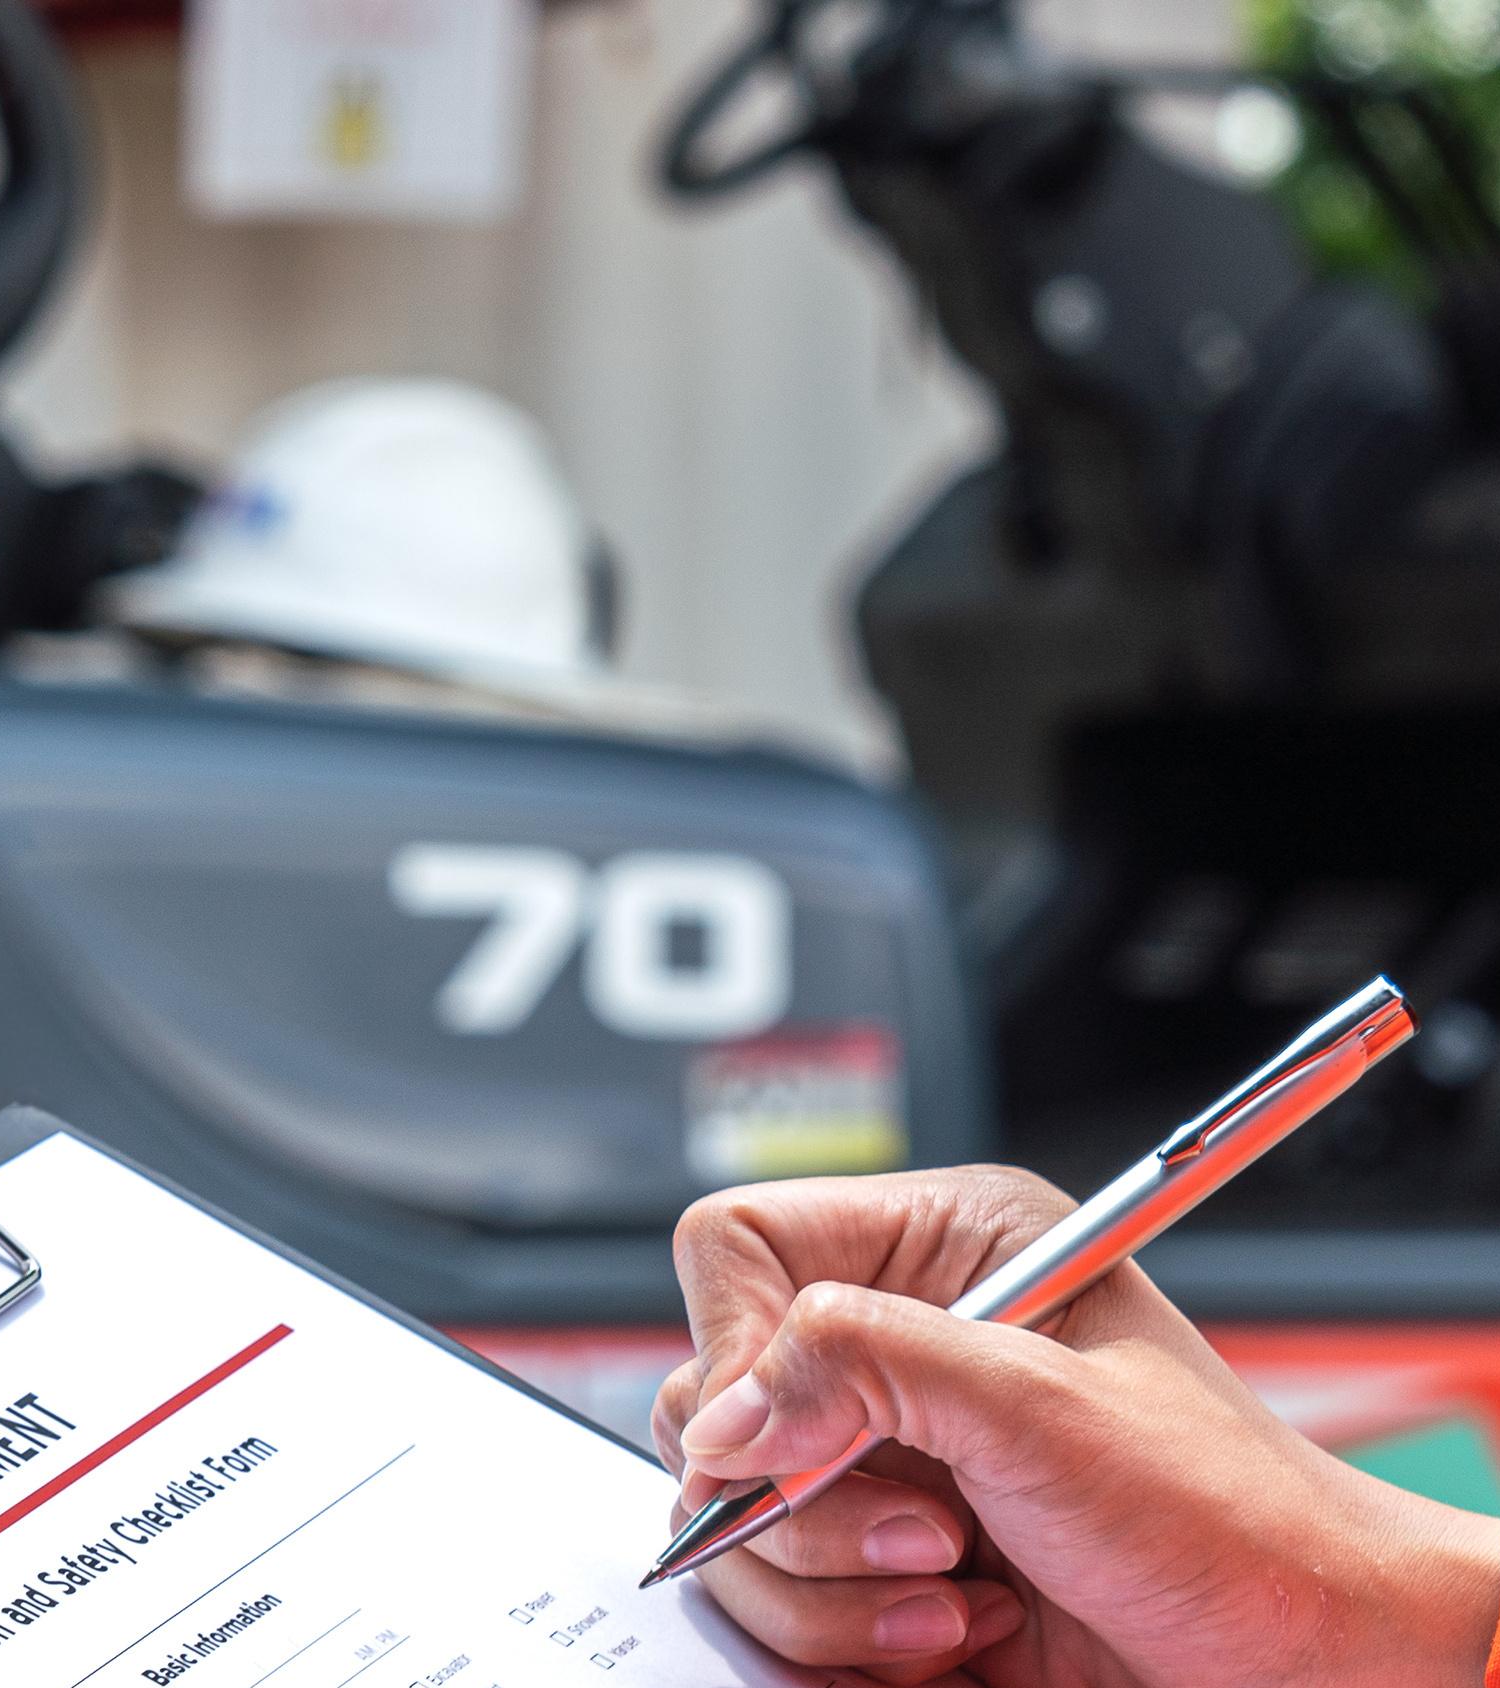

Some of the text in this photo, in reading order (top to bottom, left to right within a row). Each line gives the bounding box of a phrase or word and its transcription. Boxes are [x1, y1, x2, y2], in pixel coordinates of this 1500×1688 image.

[388, 842, 793, 1040] 70
[2, 1584, 59, 1625] and
[37, 1538, 137, 1594] Safety
[110, 1470, 225, 1545] Checklist
[202, 1437, 279, 1482] Form
[141, 1594, 282, 1686] Basic Information
